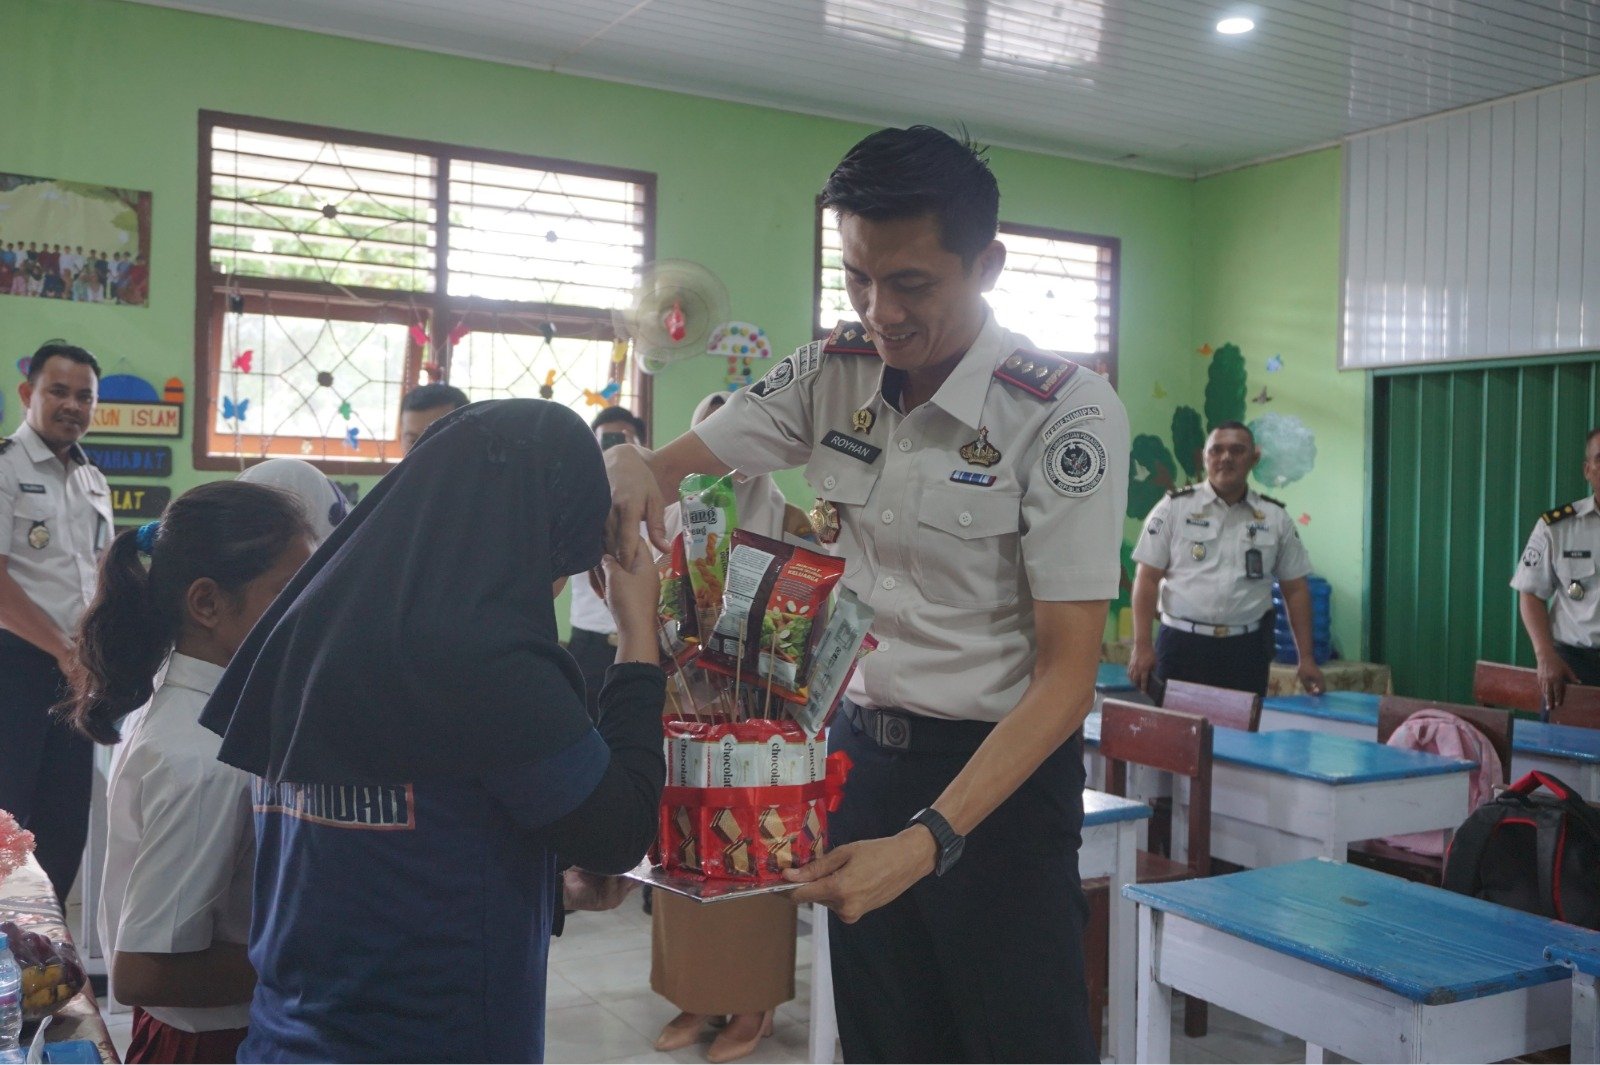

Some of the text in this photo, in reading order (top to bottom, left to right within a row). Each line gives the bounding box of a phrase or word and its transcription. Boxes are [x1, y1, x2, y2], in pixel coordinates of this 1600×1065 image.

[131, 409, 177, 427] ISLAM
[1045, 406, 1100, 439] KEMENIMIPAS
[830, 435, 871, 457] ROYHAN
[111, 490, 145, 510] LAT
